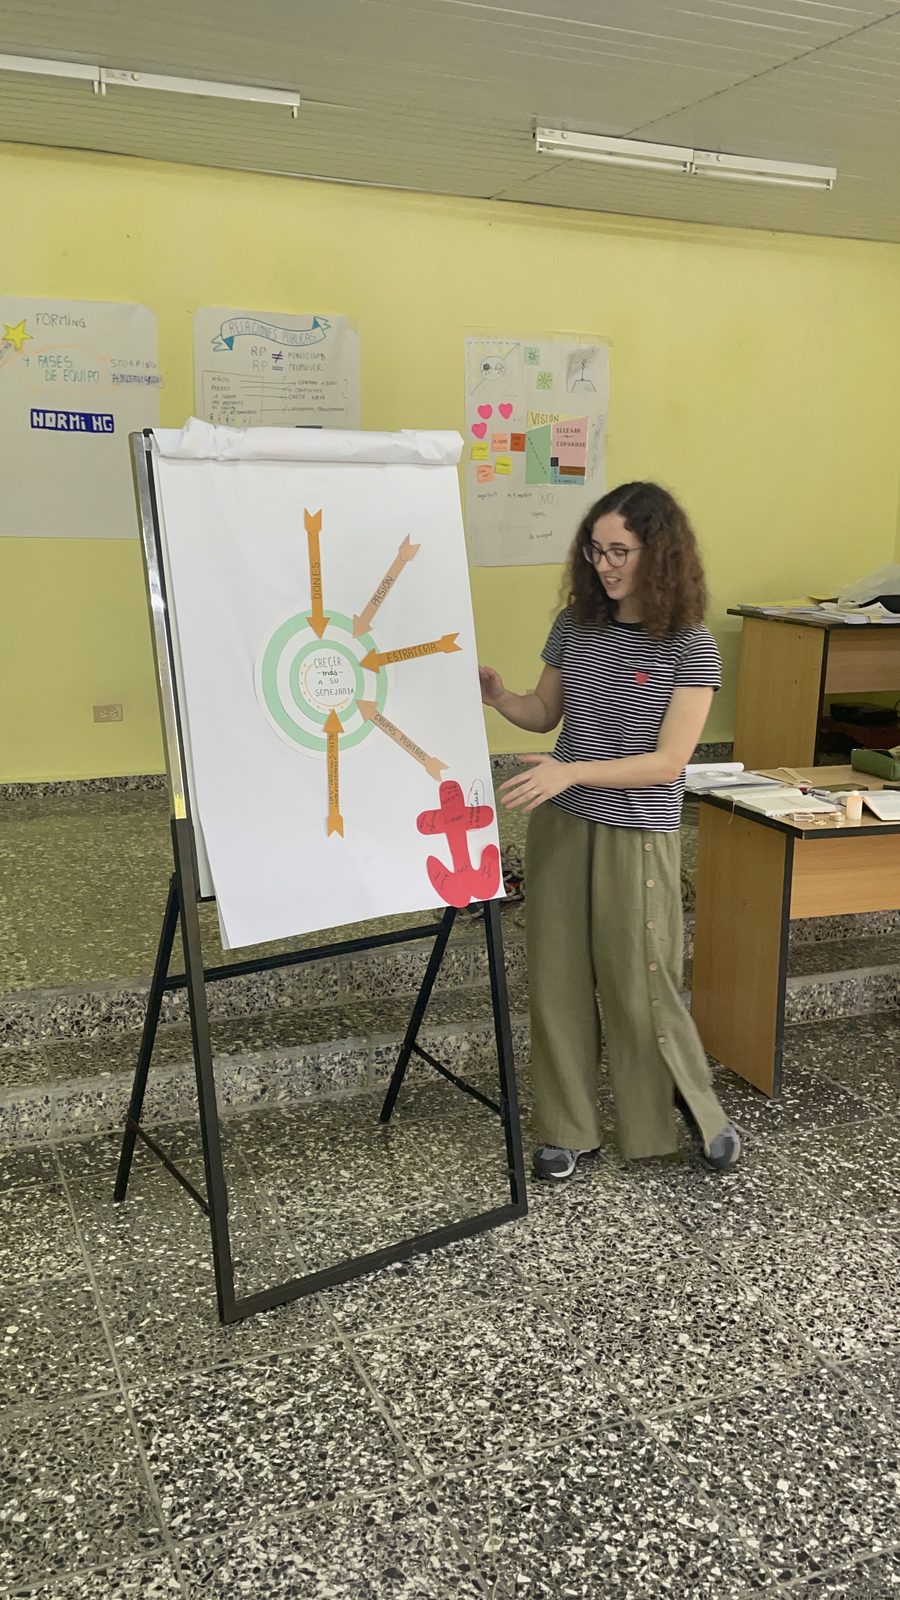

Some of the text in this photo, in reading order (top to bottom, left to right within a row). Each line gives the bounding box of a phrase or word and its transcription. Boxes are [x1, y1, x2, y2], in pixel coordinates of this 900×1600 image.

[251, 346, 267, 357] RP
[38, 354, 73, 369] FASES
[252, 361, 269, 372] RP
[44, 369, 57, 382] DE
[63, 369, 100, 383] EQUIPO
[311, 561, 321, 600] DONES
[386, 641, 437, 664] ESTRATEGIA
[329, 677, 339, 685] SU
[374, 712, 398, 737] GRUPOS
